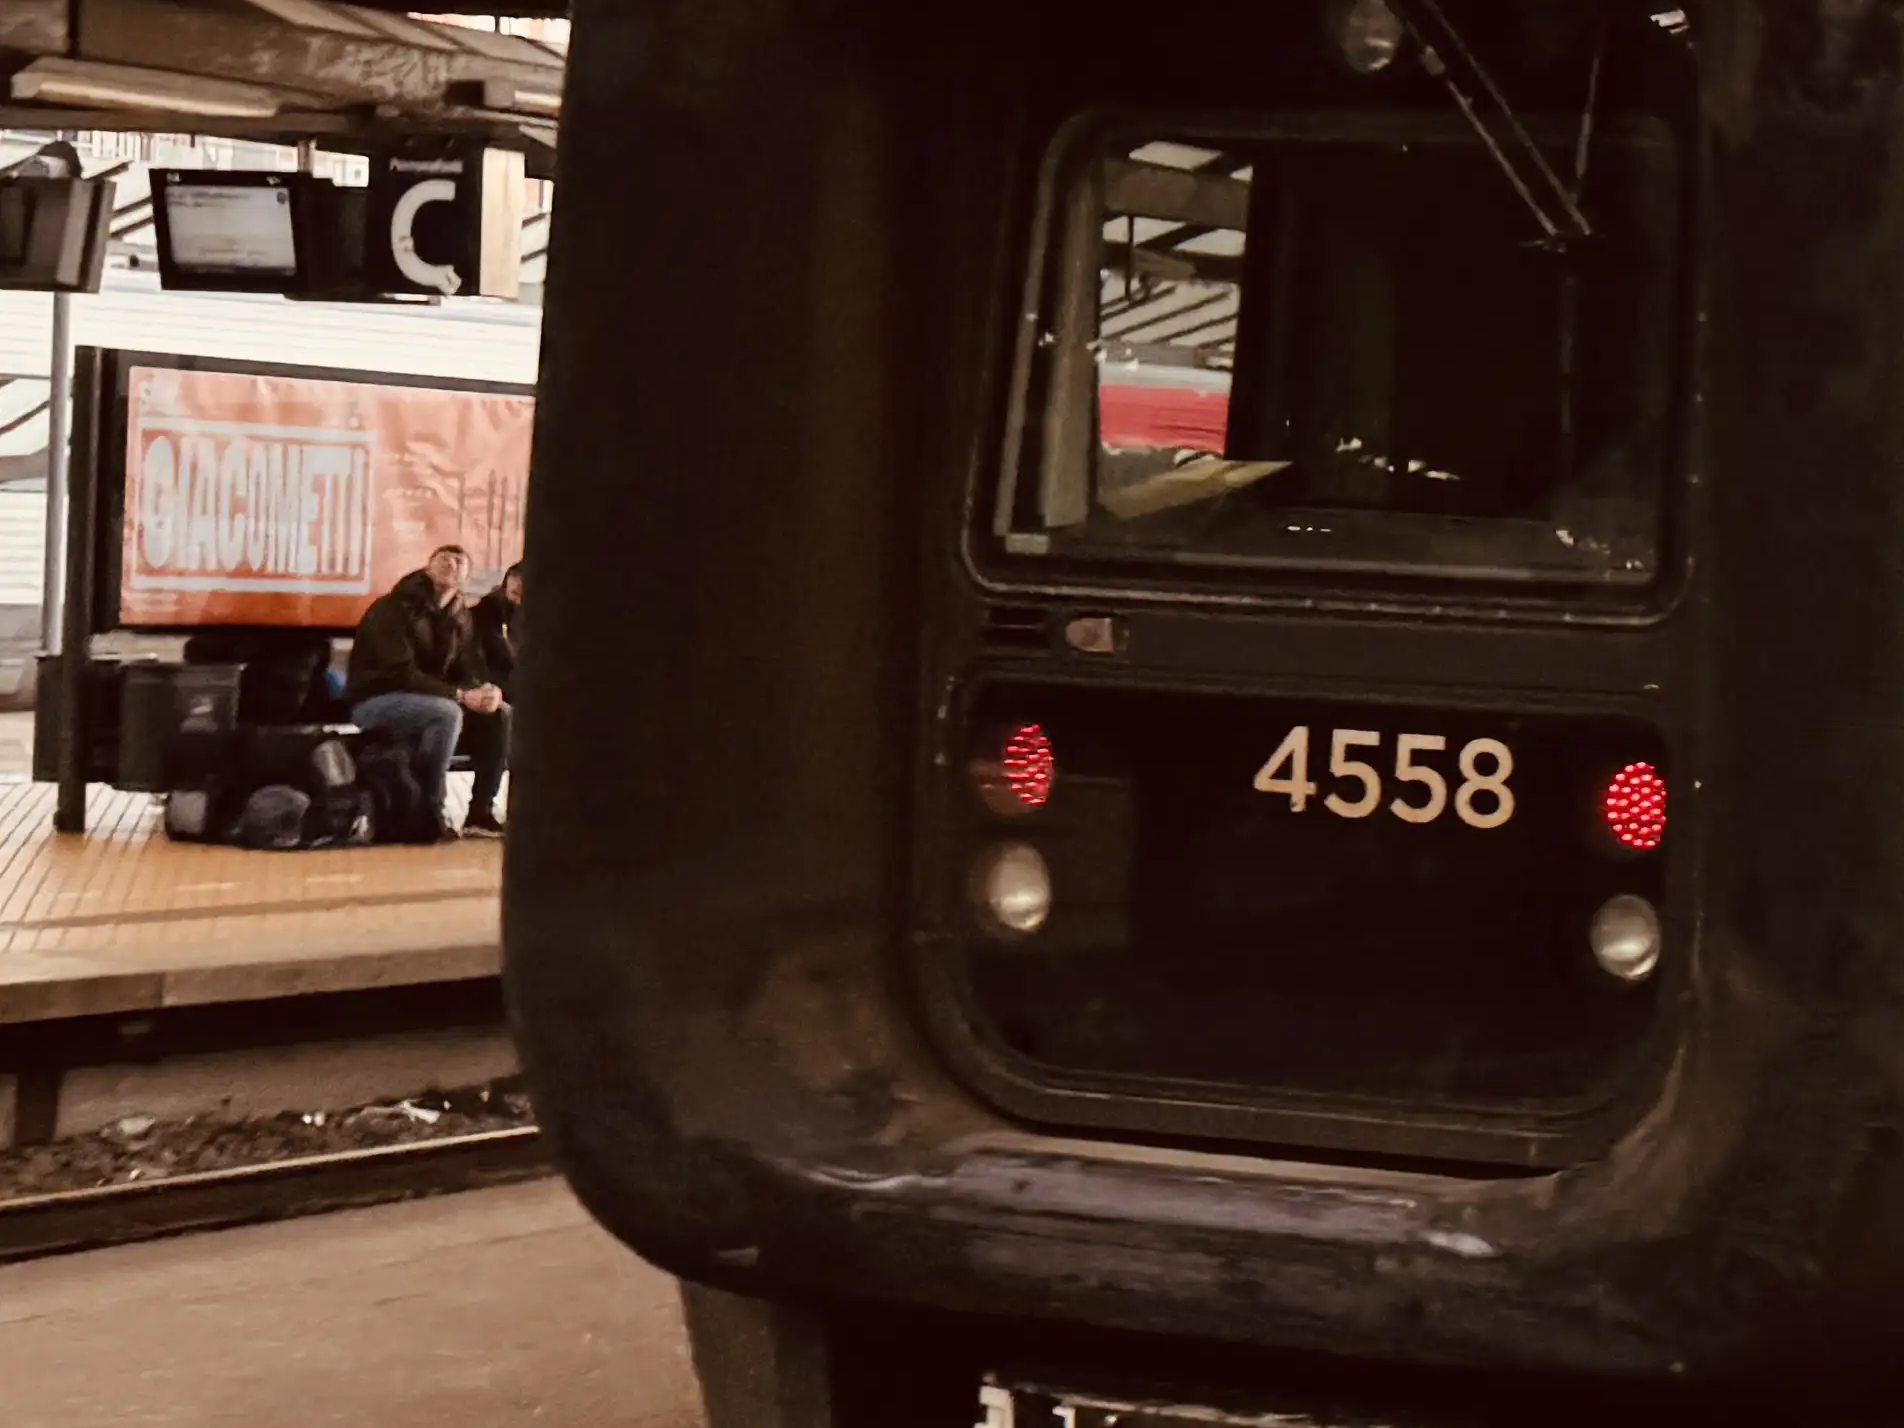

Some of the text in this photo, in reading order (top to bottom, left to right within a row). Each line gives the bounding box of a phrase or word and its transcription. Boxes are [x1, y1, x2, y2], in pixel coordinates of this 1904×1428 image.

[391, 178, 462, 294] C
[141, 435, 369, 577] GIACOMETTI
[1252, 725, 1516, 829] 4558
